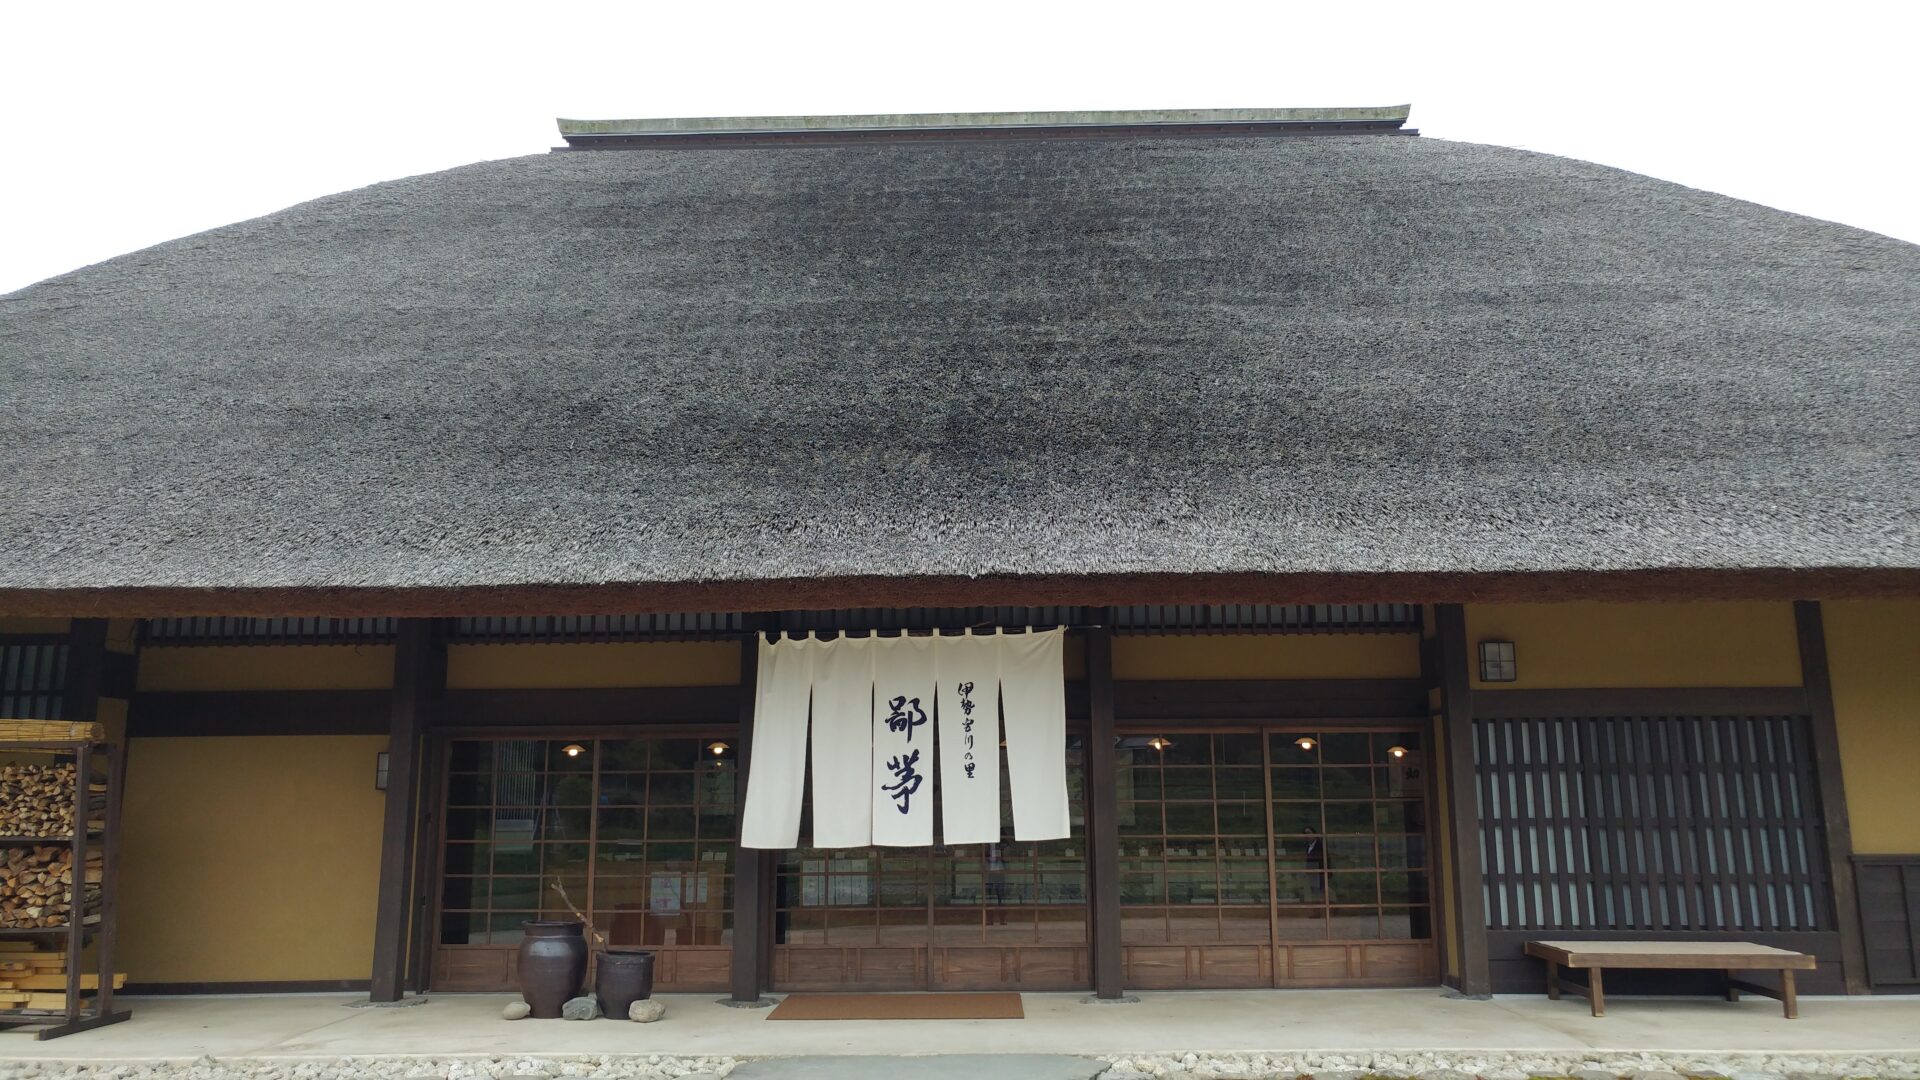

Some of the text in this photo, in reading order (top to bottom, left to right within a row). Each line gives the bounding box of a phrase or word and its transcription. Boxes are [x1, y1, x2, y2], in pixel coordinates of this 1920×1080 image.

[957, 681, 976, 779] 伊勢宮川の里
